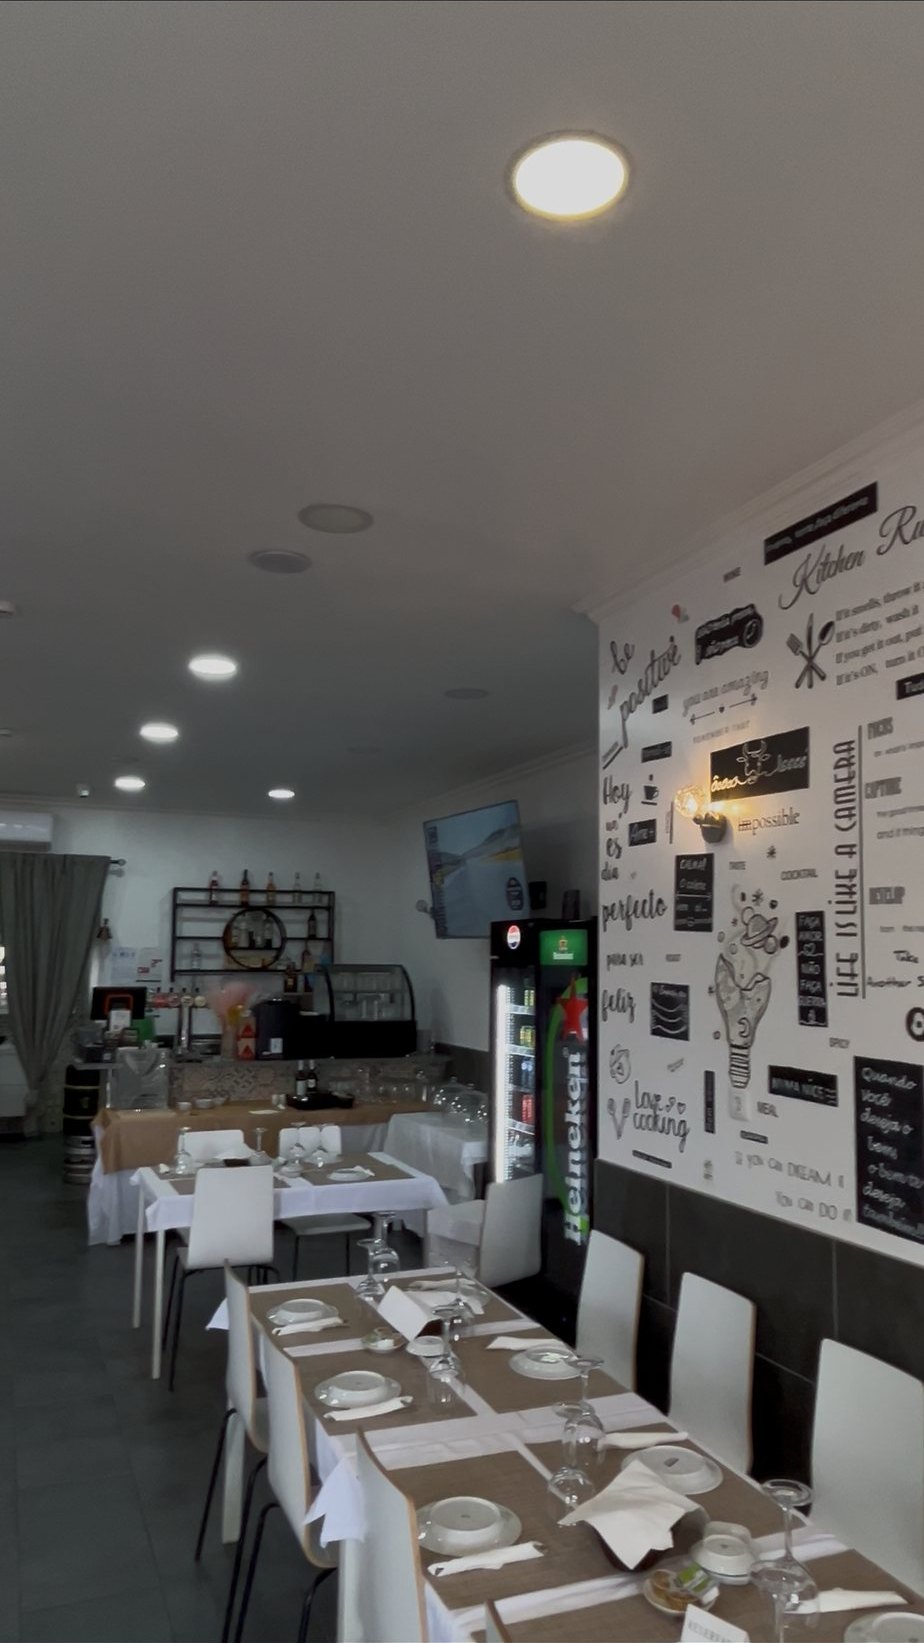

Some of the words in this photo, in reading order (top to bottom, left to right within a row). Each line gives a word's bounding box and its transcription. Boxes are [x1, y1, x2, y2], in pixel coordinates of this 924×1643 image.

[778, 544, 864, 610] Kitchen
[610, 640, 635, 675] be
[833, 740, 858, 831] CAMERA
[834, 843, 857, 857] A
[602, 889, 668, 932] perfecto
[564, 1051, 582, 1247] Heineken
[633, 1112, 690, 1153] cooking
